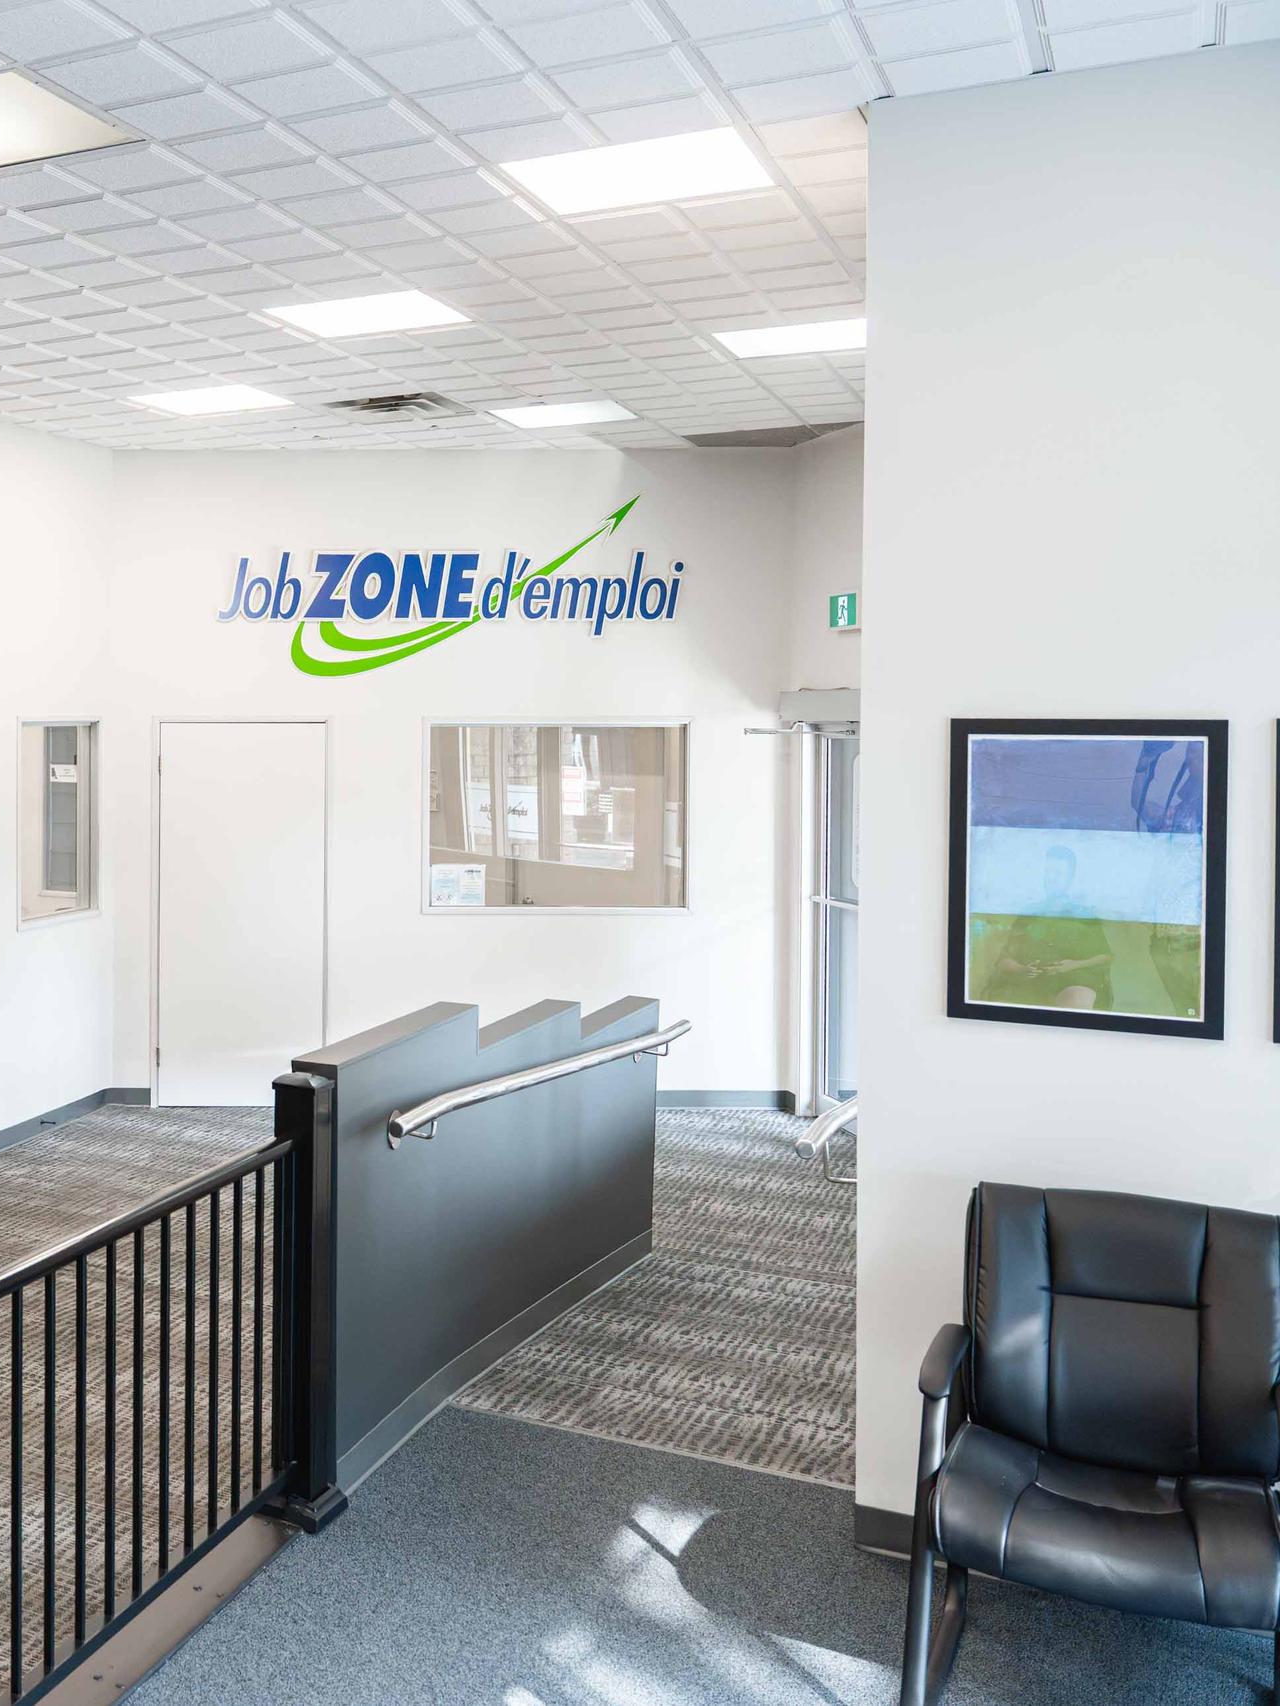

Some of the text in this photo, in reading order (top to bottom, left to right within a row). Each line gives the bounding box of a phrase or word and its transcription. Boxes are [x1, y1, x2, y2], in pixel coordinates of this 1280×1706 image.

[218, 550, 685, 637] Job ZONE d'emploi
